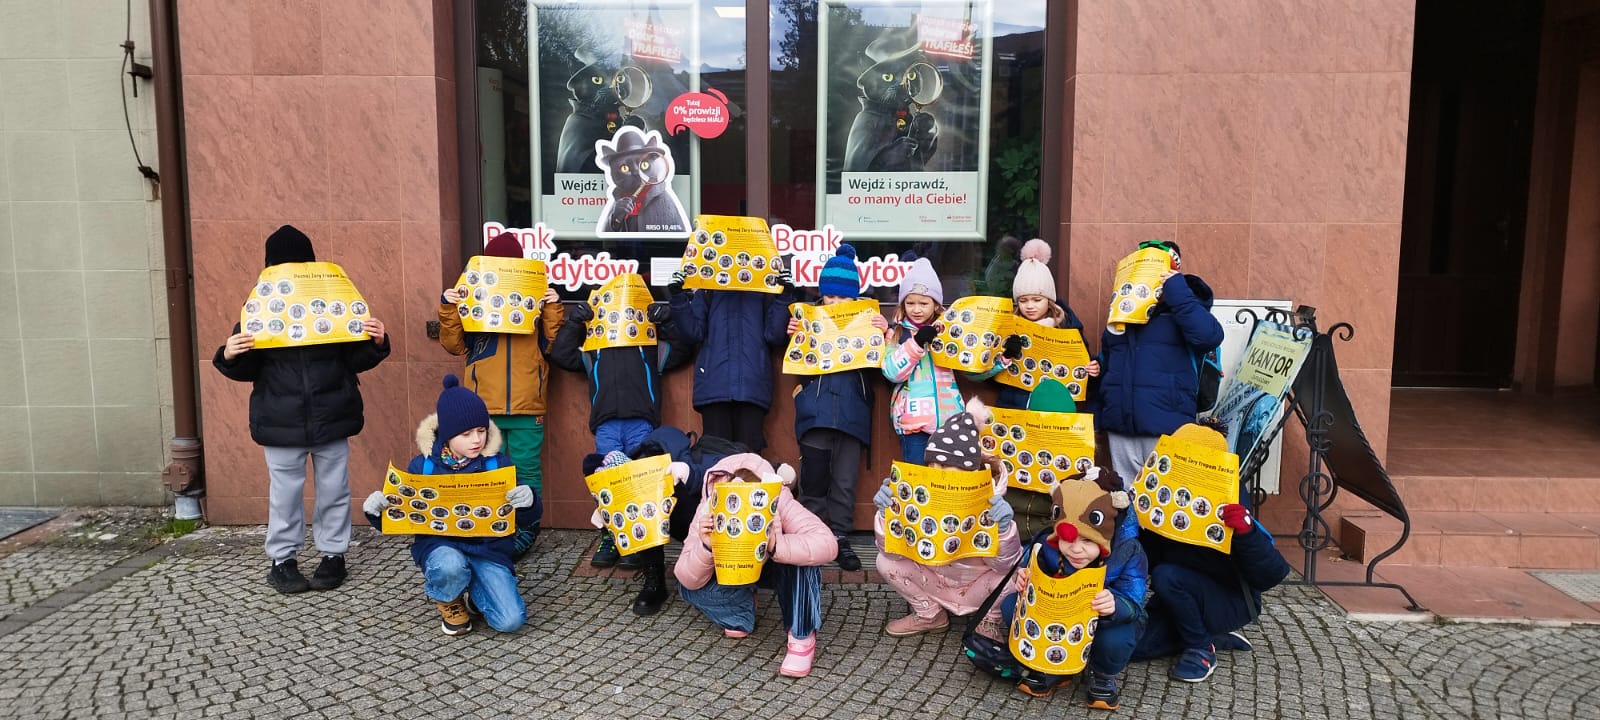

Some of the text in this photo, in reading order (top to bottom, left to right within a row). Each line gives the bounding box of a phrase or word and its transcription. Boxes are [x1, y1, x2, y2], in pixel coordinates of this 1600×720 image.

[673, 106, 721, 117] 0% prowizji
[561, 179, 604, 194] Wejdź i
[848, 178, 949, 192] Wejdź i sprawdź,
[562, 196, 608, 206] co mam
[848, 193, 967, 208] co mamy dla Ciebie!
[487, 226, 551, 250] Bnk
[776, 228, 840, 251] Bank
[531, 251, 546, 261] OD
[819, 253, 834, 263] O
[545, 257, 634, 287] dytów
[795, 258, 913, 289] Krytó
[1247, 346, 1294, 378] KANTOR
